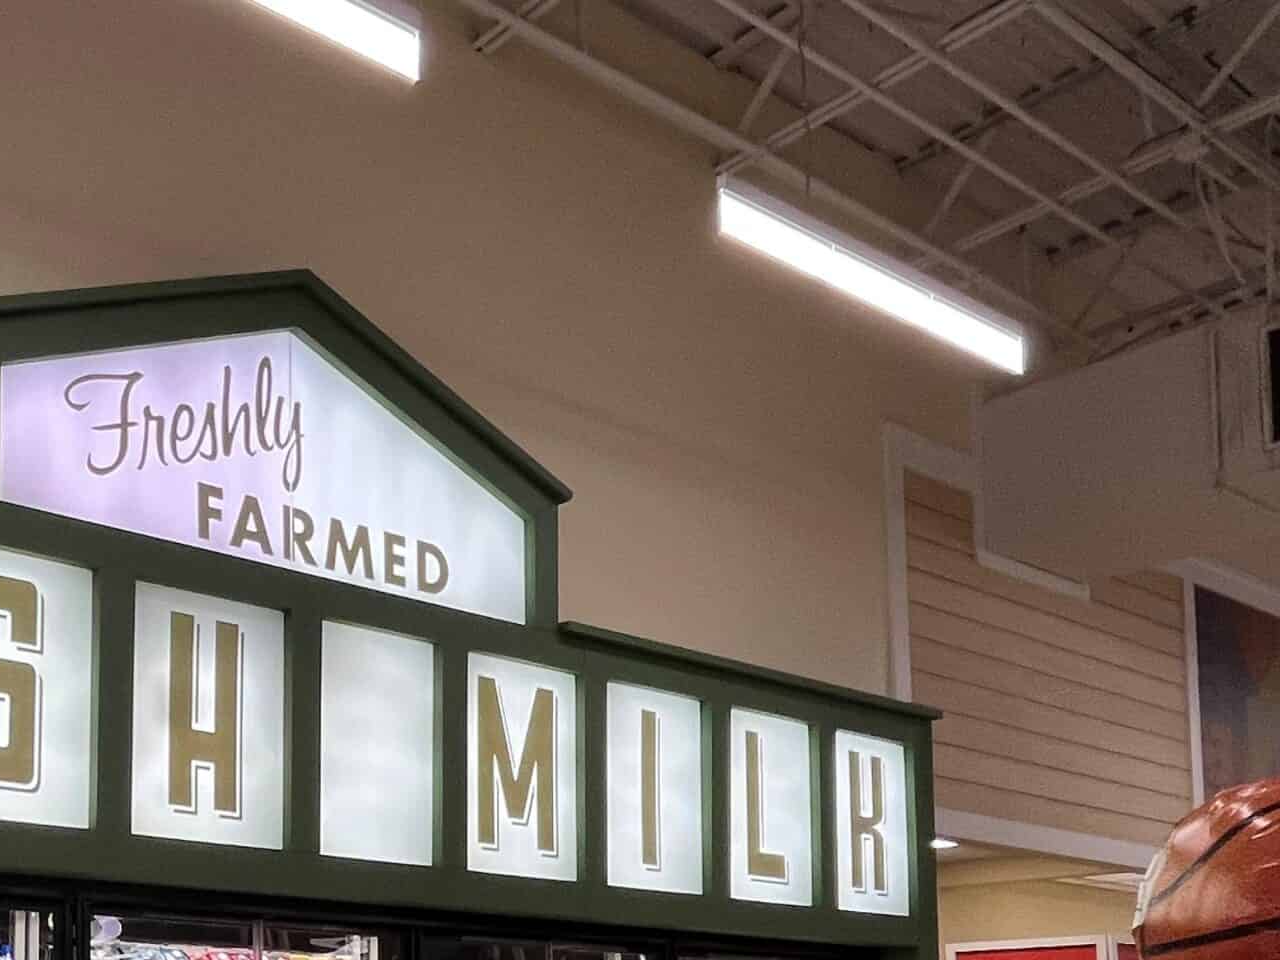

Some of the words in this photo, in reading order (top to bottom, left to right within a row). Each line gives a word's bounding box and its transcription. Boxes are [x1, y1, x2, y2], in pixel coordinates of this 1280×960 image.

[64, 356, 305, 492] Freshly
[196, 481, 450, 595] FARMED
[476, 674, 888, 898] MILK
